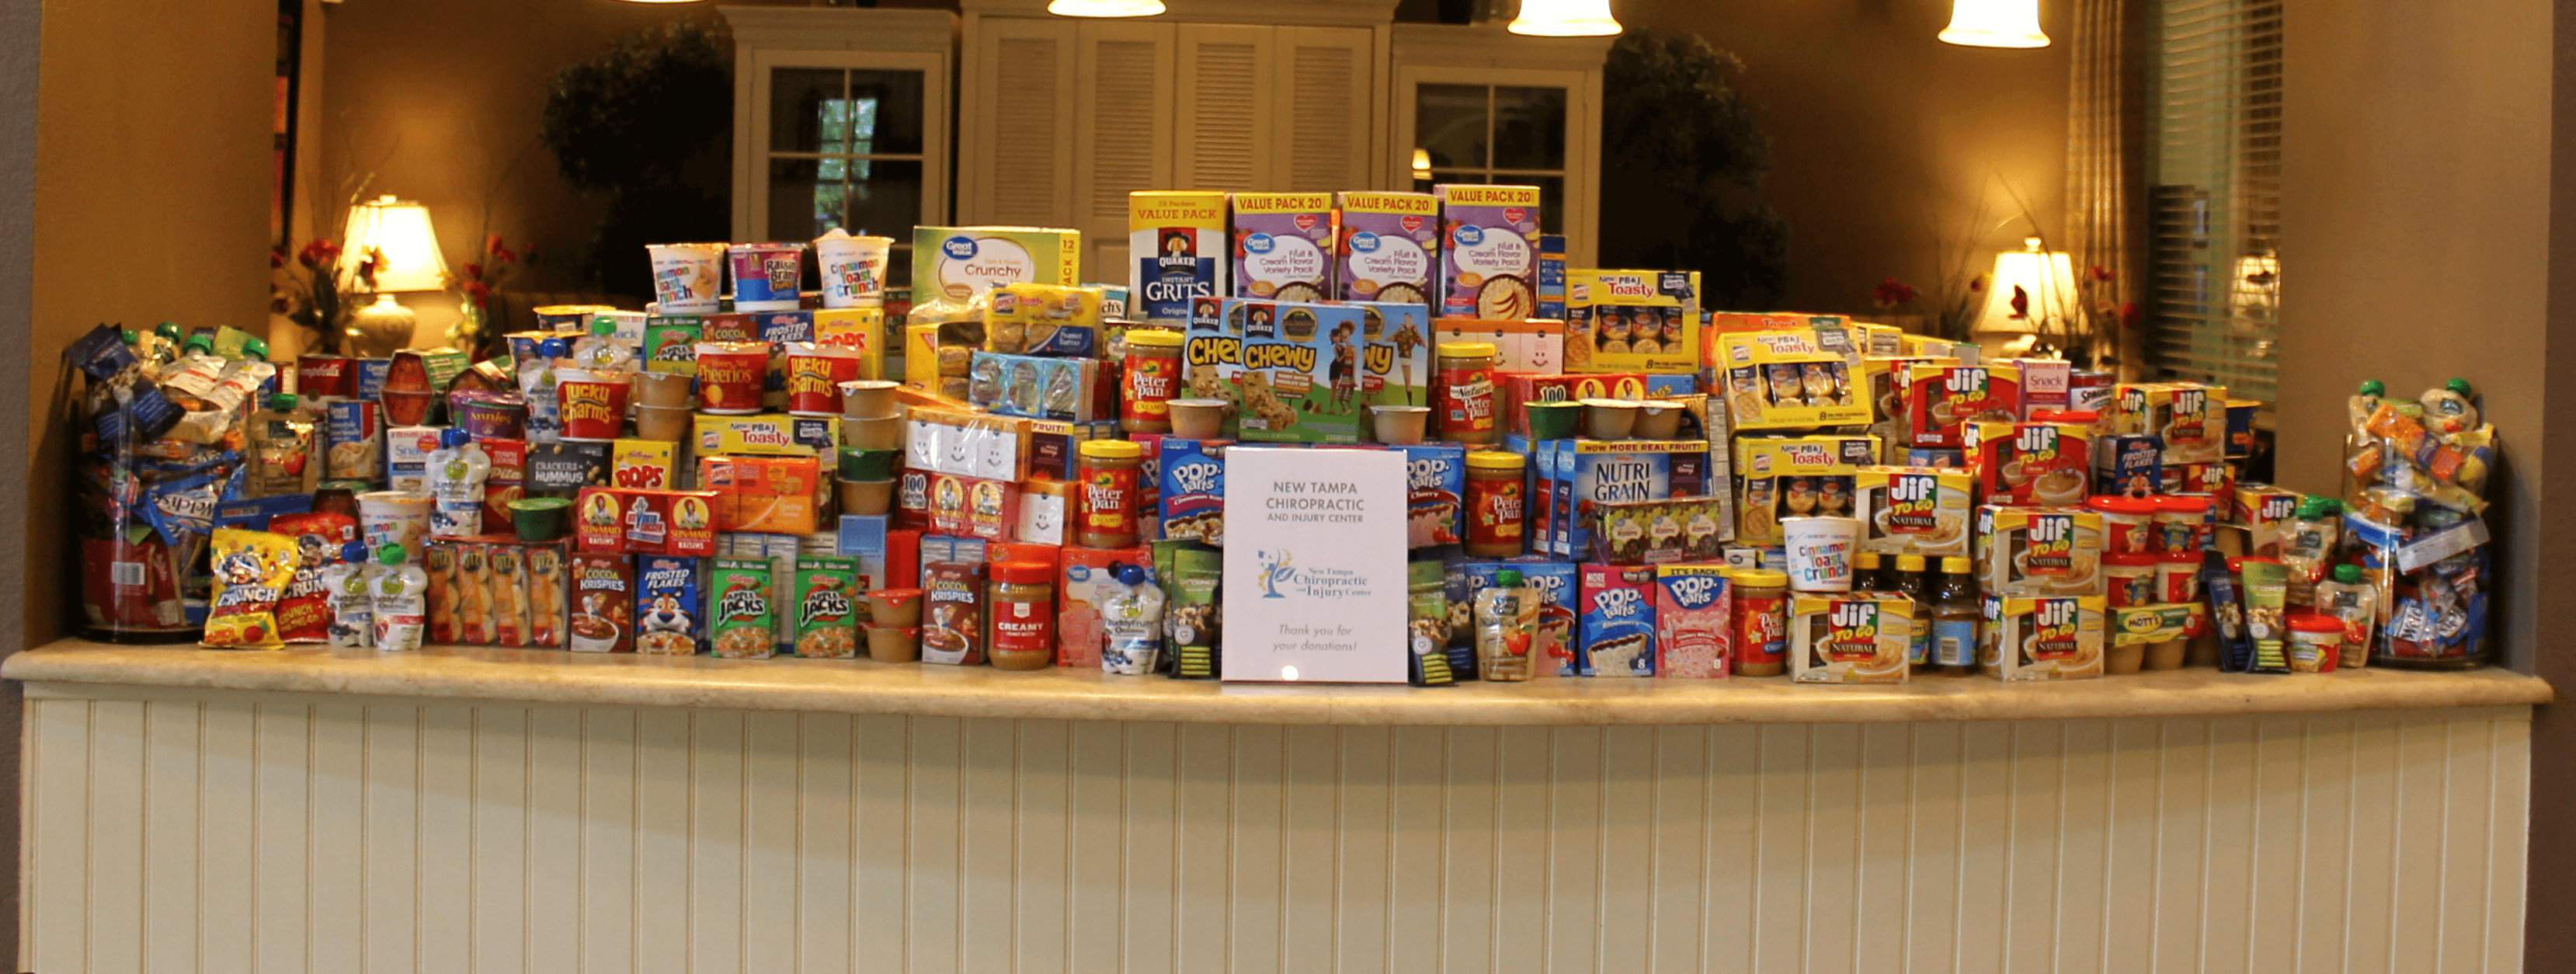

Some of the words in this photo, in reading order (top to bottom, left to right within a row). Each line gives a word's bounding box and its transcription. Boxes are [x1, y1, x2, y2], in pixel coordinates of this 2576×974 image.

[1451, 191, 1482, 202] VALUE
[1486, 191, 1514, 202] PACK
[1517, 192, 1531, 202] 20
[1239, 199, 1272, 210] VALUE
[1276, 198, 1305, 209] PACK
[1309, 198, 1321, 209] 20
[1347, 197, 1380, 208] VALUE
[1383, 199, 1411, 210] PACK
[1416, 200, 1429, 211] 20
[1138, 210, 1179, 219] VALUE
[1184, 210, 1217, 219] PACK
[1063, 241, 1074, 249] 12
[830, 259, 878, 275] Cinnamon
[1159, 256, 1196, 266] QUAKER
[841, 269, 871, 284] Toast
[964, 264, 1022, 279] Crunchy
[835, 277, 879, 297] Crunch
[1618, 277, 1642, 285] PB&J
[1145, 282, 1210, 301] GRITS
[1608, 283, 1654, 298] Toasty
[1162, 307, 1187, 317] Origin
[1192, 317, 1220, 326] QUAKER
[1246, 324, 1274, 333] QUAKER
[714, 329, 746, 339] COCOA
[765, 323, 808, 337] FROSTED
[1768, 343, 1816, 356] Toasty
[1243, 343, 1316, 373] CHEWY
[698, 364, 752, 383] Cheerios
[1133, 371, 1169, 388] Peter
[1946, 368, 1987, 391] Jif
[2029, 374, 2064, 387] Snack
[1135, 385, 1164, 400] Pan
[1949, 395, 1966, 407] TO
[1967, 390, 1987, 402] GO
[1461, 398, 1491, 411] Peter
[2120, 392, 2144, 412] Jif
[2174, 391, 2205, 414] Jif
[751, 422, 776, 433] PB&J
[1032, 423, 1065, 432] FRUIT!
[741, 430, 791, 447] Toasty
[2015, 426, 2057, 451] Jif
[1800, 444, 1823, 454] PB&J
[2122, 449, 2157, 461] FROSTED
[1790, 451, 1837, 467] Toasty
[2019, 454, 2036, 466] TO
[2037, 449, 2056, 460] GO
[2124, 457, 2155, 469] FLAKES
[535, 461, 578, 471] CRACKERS
[488, 467, 523, 481] Pita
[535, 471, 584, 483] HUMMUS
[615, 465, 666, 489] POPS
[1596, 463, 1651, 485] NUTRI
[2201, 468, 2225, 484] Jif
[903, 474, 926, 492] 100
[1273, 481, 1305, 493] NEW
[1311, 482, 1358, 494] TAMPA
[1890, 477, 1935, 501] Jif
[1086, 482, 1124, 501] Peter
[1594, 480, 1650, 502] GRAIN
[1090, 497, 1120, 513] Pan
[1266, 497, 1365, 511] CHIROPRACTIC
[1490, 495, 1522, 511] Peter
[1894, 503, 1913, 516] TO
[1914, 499, 1935, 511] GO
[2261, 499, 2295, 519] Jif
[1267, 513, 1289, 522] AND
[1291, 513, 1325, 523] INJURY
[1329, 514, 1364, 523] CENTER
[1890, 517, 1932, 526] NATURAL
[2029, 517, 2071, 542] Jif
[588, 537, 615, 546] RAISINS
[677, 541, 704, 550] RAISINS
[2032, 544, 2050, 557] TO
[2052, 539, 2070, 551] GO
[1799, 541, 1850, 557] Cinnamon
[1810, 553, 1842, 568] Toast
[2028, 557, 2069, 567] NATURAL
[585, 569, 619, 579] COCOA
[645, 569, 690, 581] FROSTED
[1327, 568, 1354, 576] Tampa
[1803, 562, 1849, 582] Crunch
[579, 579, 625, 592] KRISPIES
[646, 579, 686, 590] FLAKES
[936, 580, 968, 592] COCOA
[1293, 573, 1368, 588] Chiropractic
[726, 592, 754, 601] APPLE
[809, 592, 838, 601] APPLE
[930, 590, 975, 604] KRISPIES
[1306, 585, 1345, 599] Injury
[718, 599, 765, 626] JACKS
[800, 599, 850, 627] JACKS
[1831, 603, 1876, 628] Jif
[2037, 600, 2077, 627] Jif
[997, 621, 1044, 632] CREAMY
[1757, 612, 1784, 628] Pete
[2128, 615, 2160, 628] MOTT'S
[1279, 623, 1310, 635] Thank
[1313, 627, 1333, 638] you
[1337, 624, 1353, 636] for
[1835, 629, 1853, 643] TO
[1855, 624, 1876, 638] GO
[2040, 628, 2057, 642] TO
[2059, 623, 2076, 636] GO
[1272, 641, 1298, 653] your
[1300, 639, 1358, 652] donations!
[1831, 643, 1876, 653] NATURAL
[2038, 642, 2075, 651] NATURAL
[1559, 658, 1568, 669] 8
[1638, 658, 1646, 670] 8
[1713, 658, 1722, 670] 8
